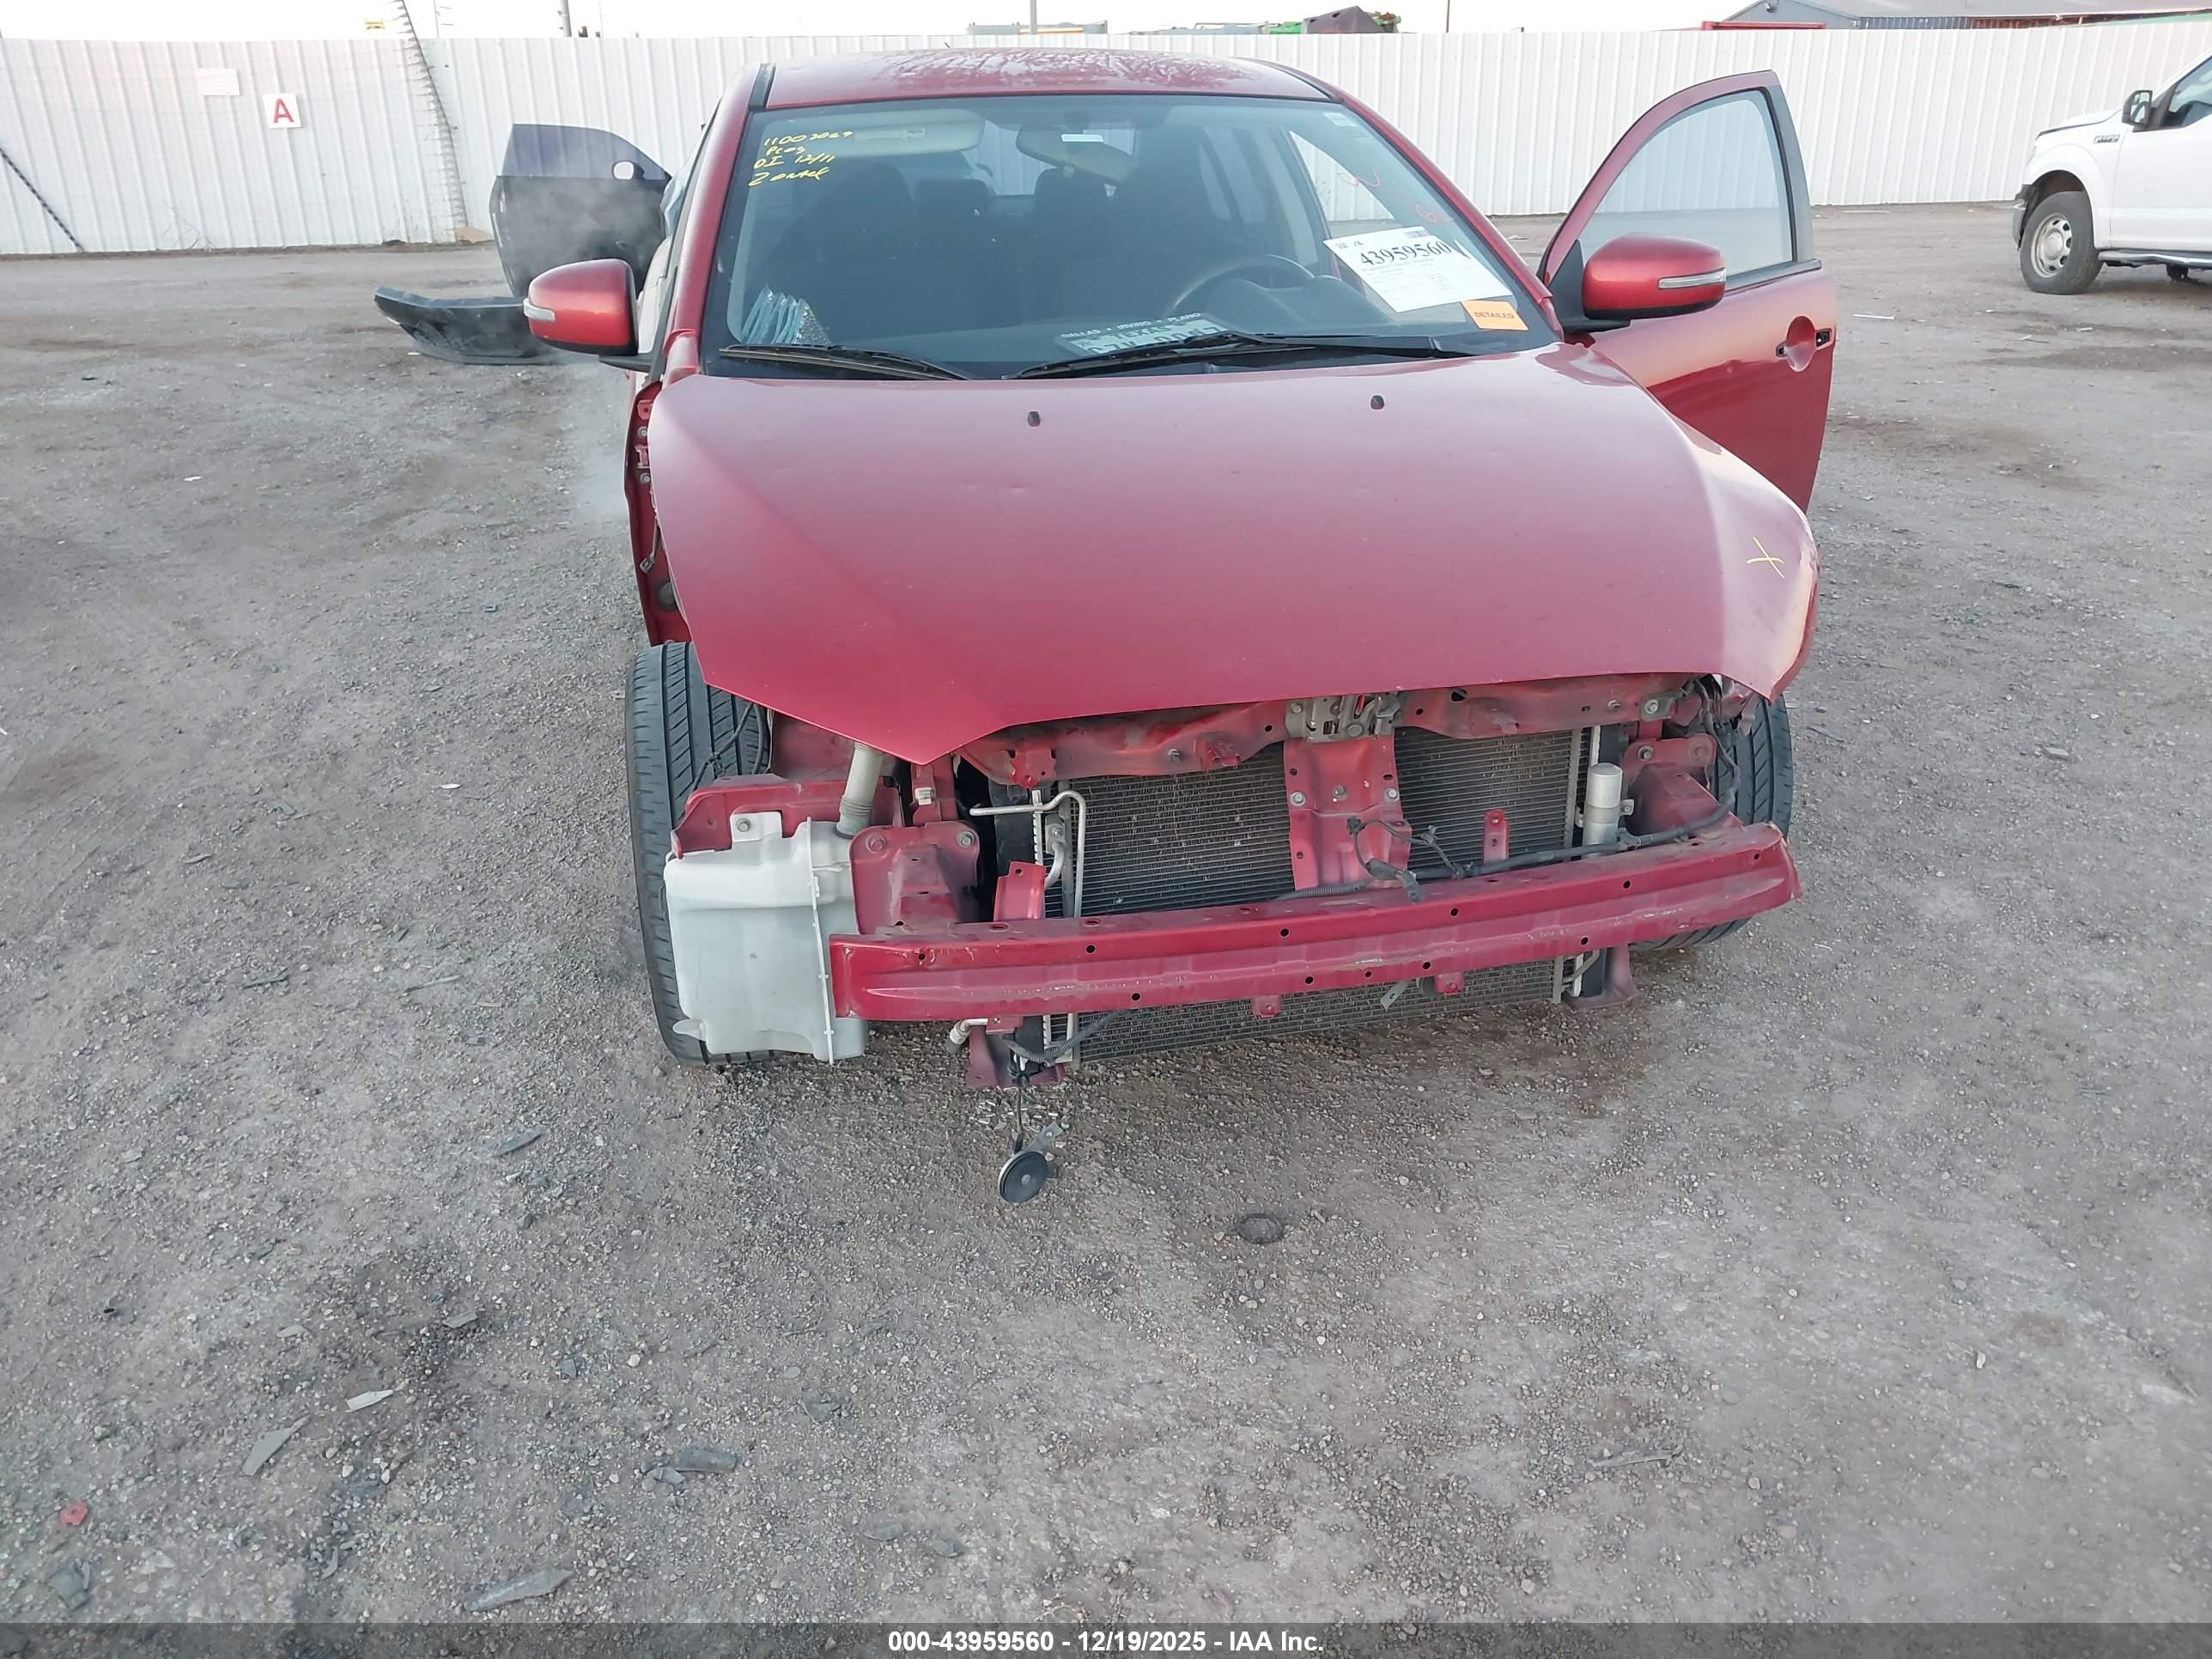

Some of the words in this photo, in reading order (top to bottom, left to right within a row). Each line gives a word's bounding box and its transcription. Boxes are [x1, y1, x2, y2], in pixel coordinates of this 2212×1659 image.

[272, 98, 295, 124] A
[1360, 240, 1452, 265] 43959560
[1060, 329, 1102, 338] DALLAS
[1167, 313, 1201, 322] PLANO
[1474, 311, 1515, 320] DETAILED
[1112, 325, 1171, 340] TEXAS
